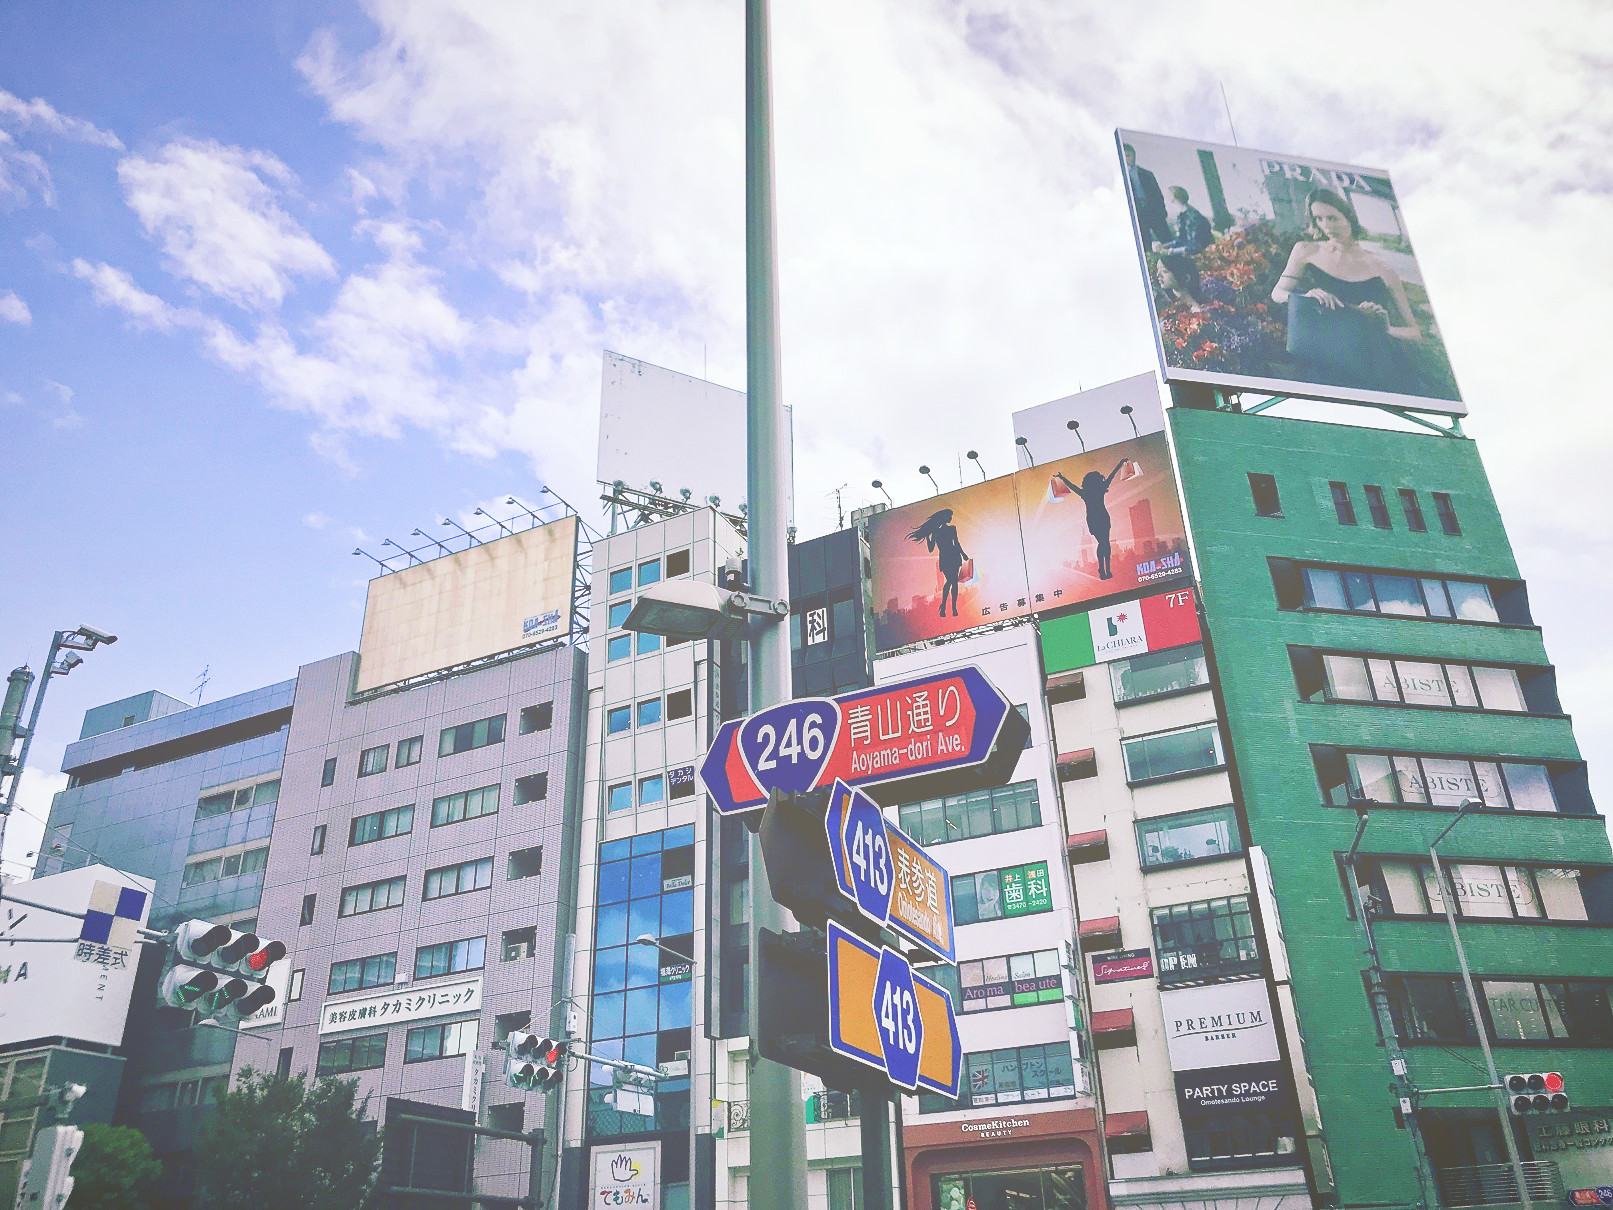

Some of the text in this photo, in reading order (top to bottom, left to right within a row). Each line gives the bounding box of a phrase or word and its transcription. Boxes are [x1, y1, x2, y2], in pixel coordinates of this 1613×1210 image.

[1260, 159, 1372, 192] PRADA
[982, 589, 1063, 616] 広告募集中
[1165, 591, 1189, 608] 7F
[808, 609, 827, 644] 科
[1383, 675, 1460, 693] ABISTE
[847, 685, 961, 748] 青山通り
[755, 713, 826, 772] 246
[851, 736, 966, 775] Aoyama-dori Ave.
[669, 767, 692, 778] タカシ
[671, 775, 693, 785] デンタル
[1409, 774, 1489, 793] ABISTE
[852, 820, 888, 896] 413
[897, 847, 940, 916] 表参道
[1004, 879, 1048, 903] 歯科
[1436, 882, 1521, 899] ABISTE
[75, 942, 129, 968] 時差式
[1160, 953, 1198, 972] OPEN
[964, 978, 1057, 999] Aroma beaute
[379, 987, 475, 1017] タカミクリニック
[256, 1006, 277, 1019] AMI
[881, 980, 916, 1055] 413
[1175, 1010, 1263, 1032] PREMIUM
[1204, 1032, 1237, 1042] BARBER
[1184, 1080, 1279, 1100] PARTY SPACE
[1200, 1094, 1266, 1106] Omotesando Lounge
[961, 1118, 1030, 1132] CosmeKitchen
[980, 1129, 1012, 1138] BEAUTY
[600, 1187, 649, 1206] てもみん
